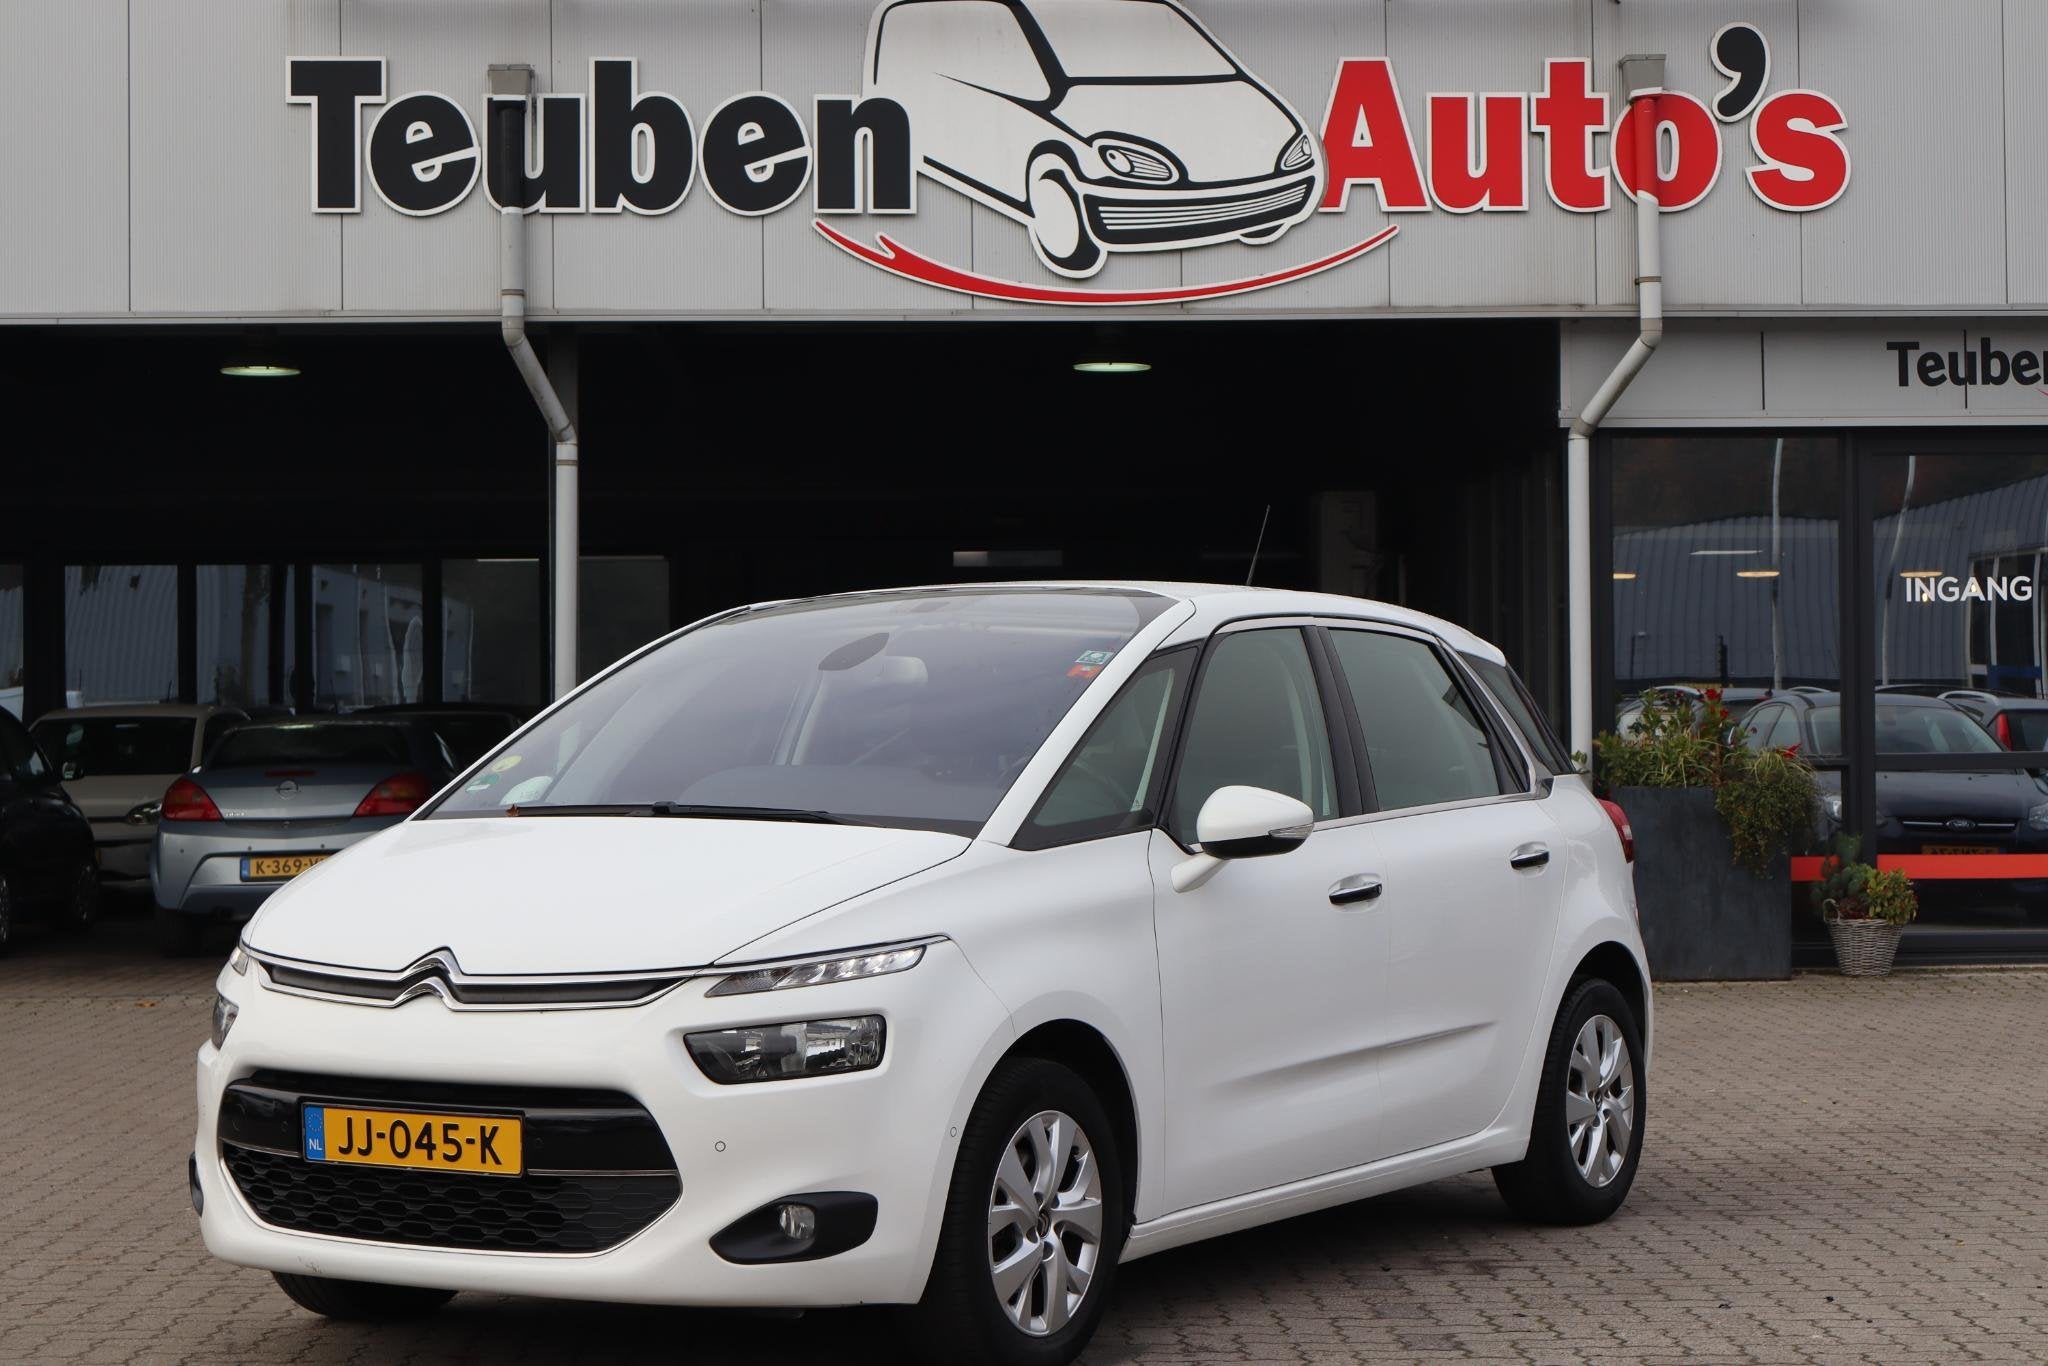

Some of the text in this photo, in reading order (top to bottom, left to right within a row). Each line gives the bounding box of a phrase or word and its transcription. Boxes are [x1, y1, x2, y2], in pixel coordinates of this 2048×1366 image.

[287, 22, 1850, 216] Teuben Auto's
[1886, 336, 2048, 387] Teube
[1906, 575, 2032, 602] INGANG
[308, 1138, 323, 1151] NL
[338, 1117, 502, 1165] JJ-045-K
